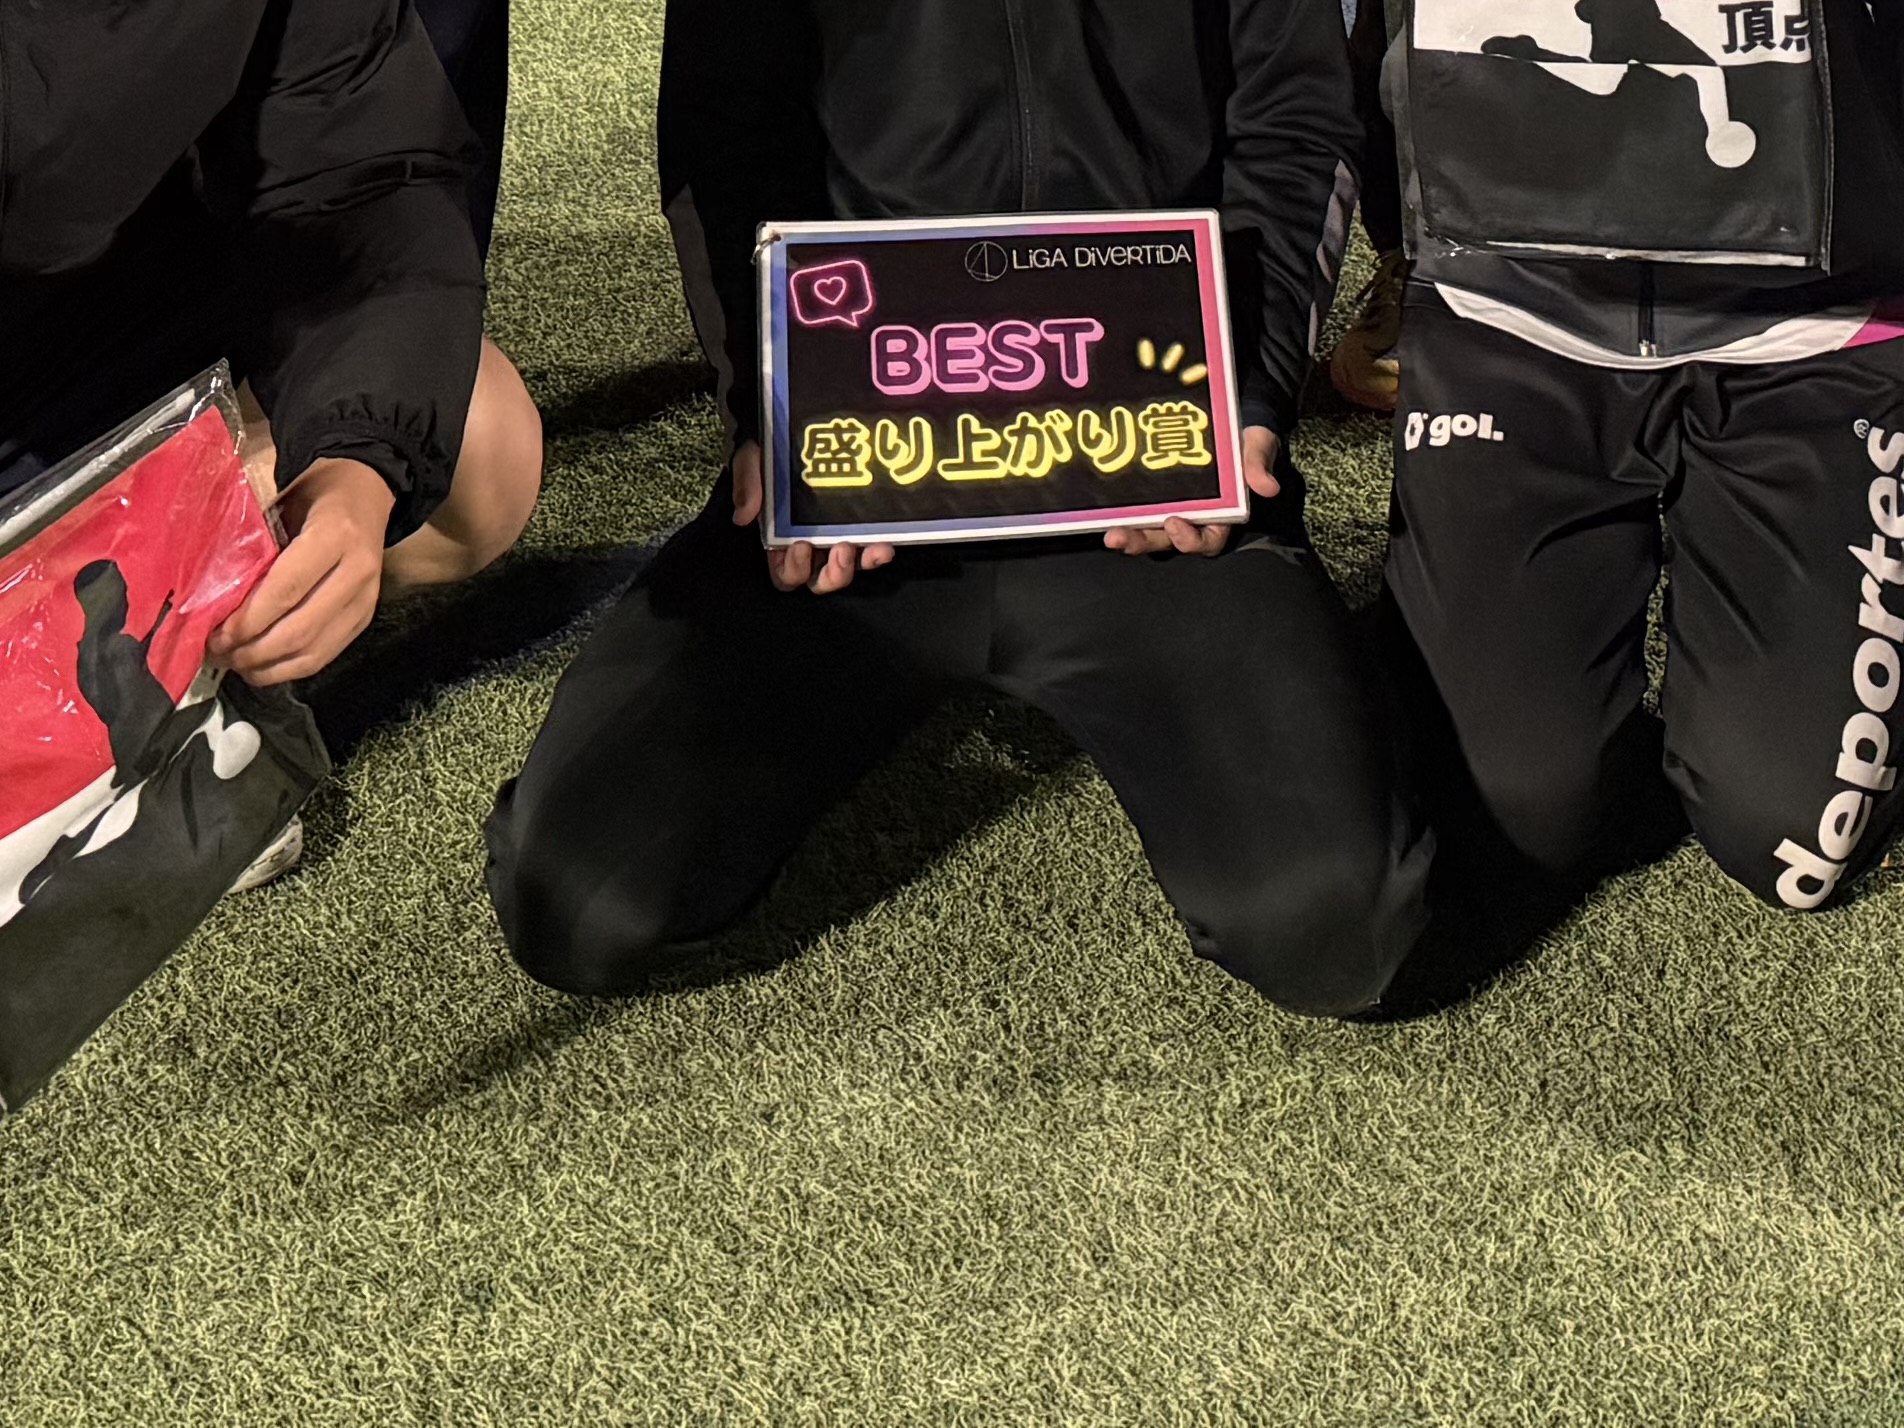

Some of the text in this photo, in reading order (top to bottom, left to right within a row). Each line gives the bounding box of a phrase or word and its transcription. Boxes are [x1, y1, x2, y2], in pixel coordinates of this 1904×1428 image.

[870, 317, 1105, 396] BEST
[801, 400, 1213, 488] 盛り上がり賞
